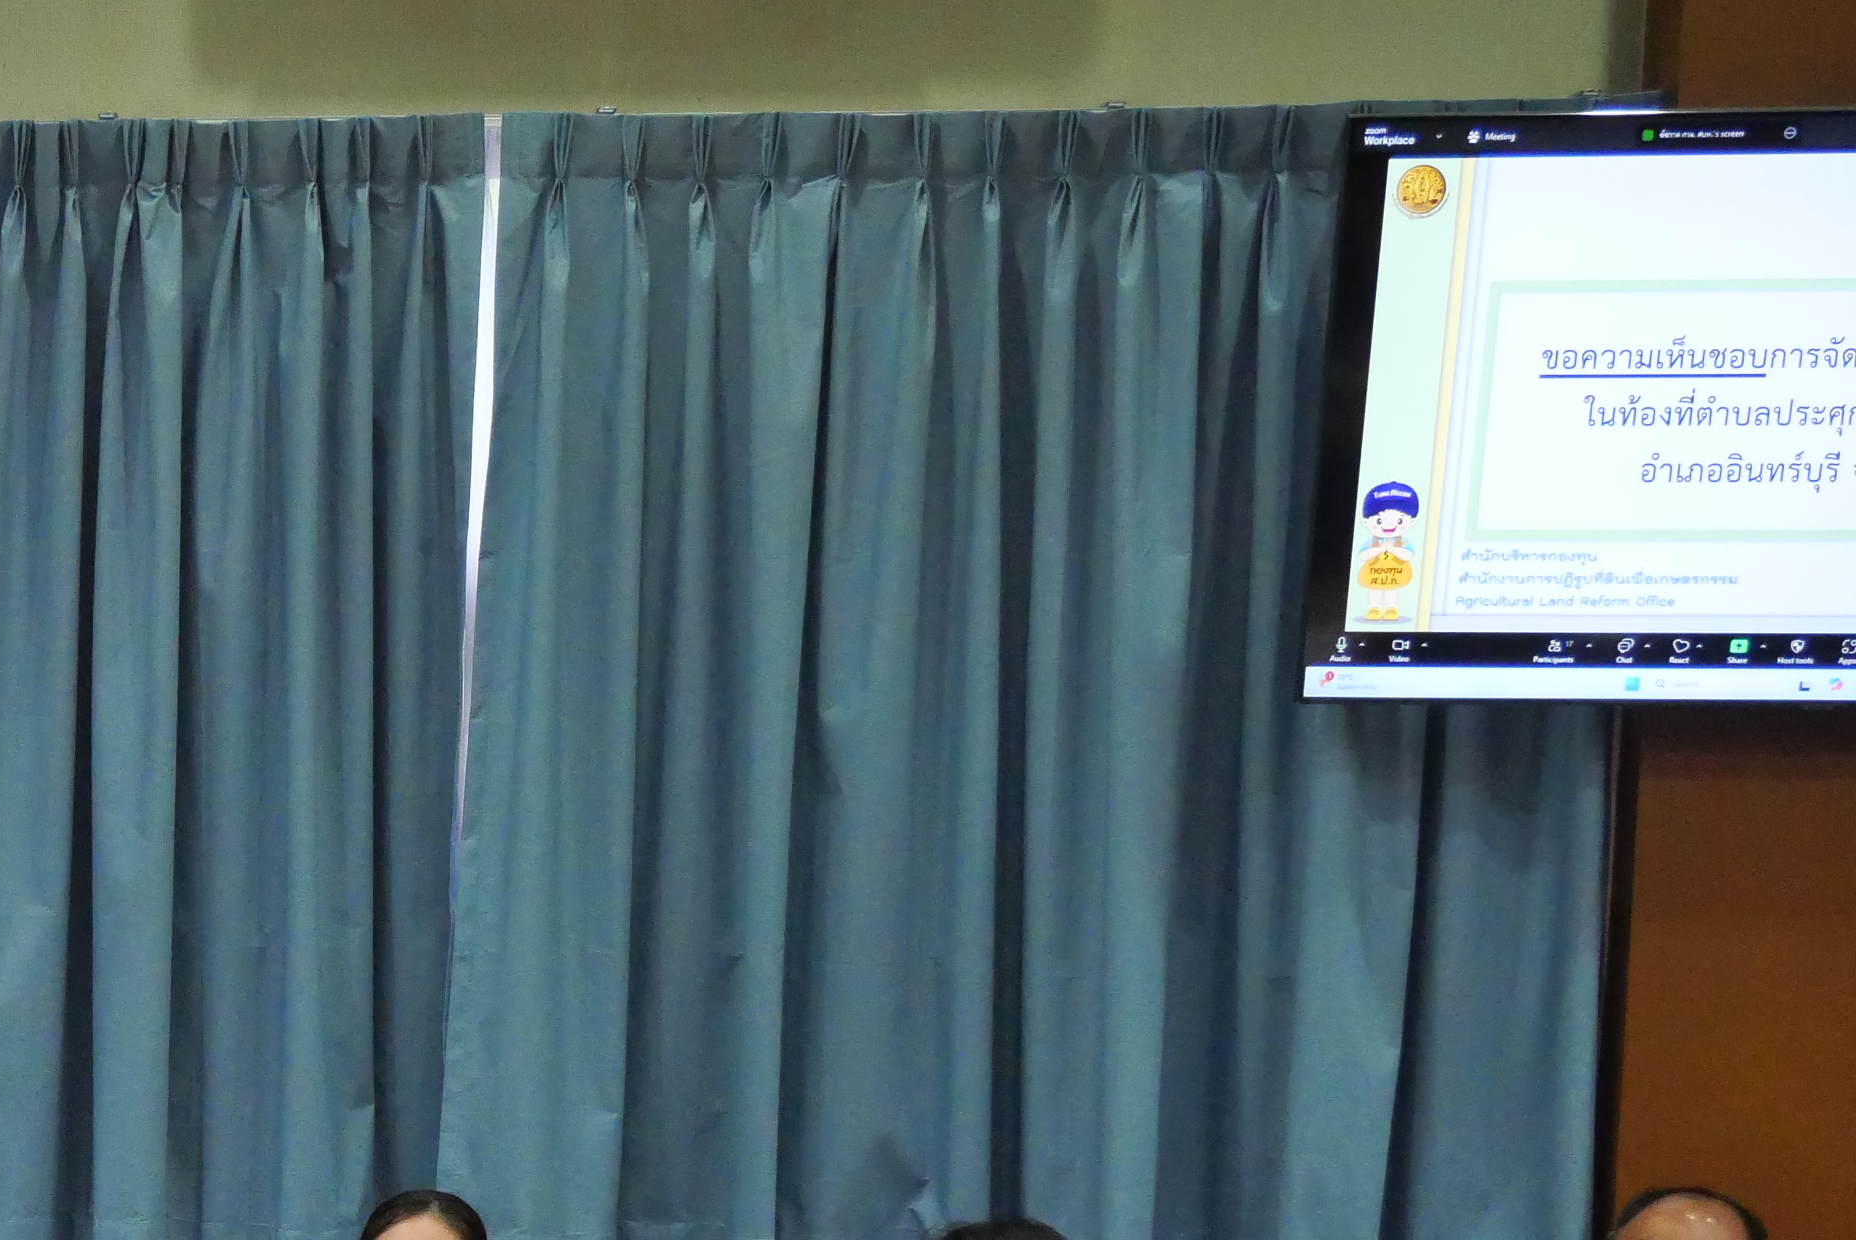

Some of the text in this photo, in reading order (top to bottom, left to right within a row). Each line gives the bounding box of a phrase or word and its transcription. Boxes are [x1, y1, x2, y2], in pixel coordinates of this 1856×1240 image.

[1365, 127, 1387, 135] zoom
[1364, 136, 1415, 146] Workplace
[1485, 132, 1516, 142] Meeting
[1641, 451, 1841, 493] อำเภออินทร์บุรี
[1461, 549, 1597, 566] สำนักบริหารกองทุน
[1369, 567, 1403, 577] กองทุน
[1458, 567, 1737, 589] สำนักงานการปฏิรูปที่ดินเพื่อเกษตรกรรม
[1455, 595, 1675, 609] Agricultural Land Reform Office
[1533, 656, 1574, 664] Participants
[1669, 656, 1689, 664] React
[1727, 656, 1747, 664] Share
[1777, 656, 1813, 664] Host tools
